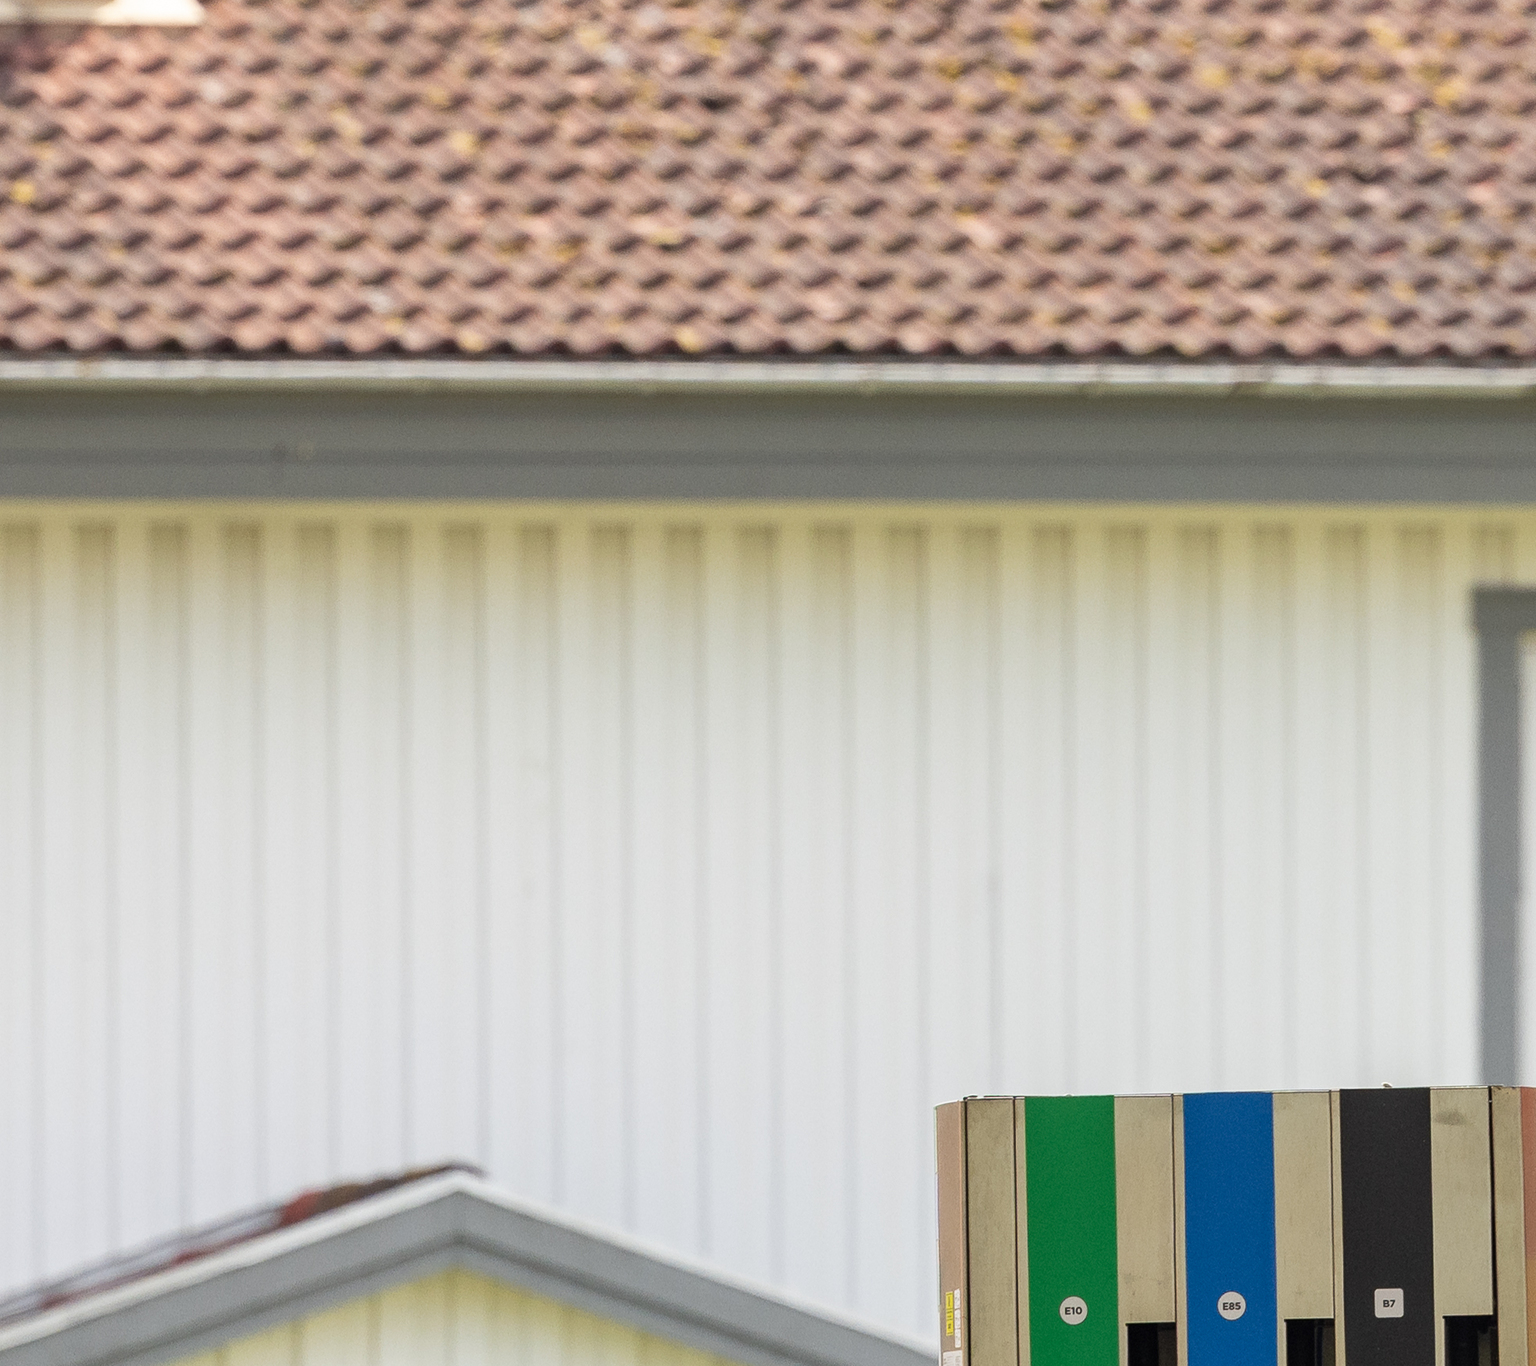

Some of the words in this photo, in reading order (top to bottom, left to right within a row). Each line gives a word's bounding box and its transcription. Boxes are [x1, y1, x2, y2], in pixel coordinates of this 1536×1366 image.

[1222, 1302, 1241, 1311] E85
[1382, 1299, 1395, 1308] B7
[1064, 1306, 1082, 1315] E10
